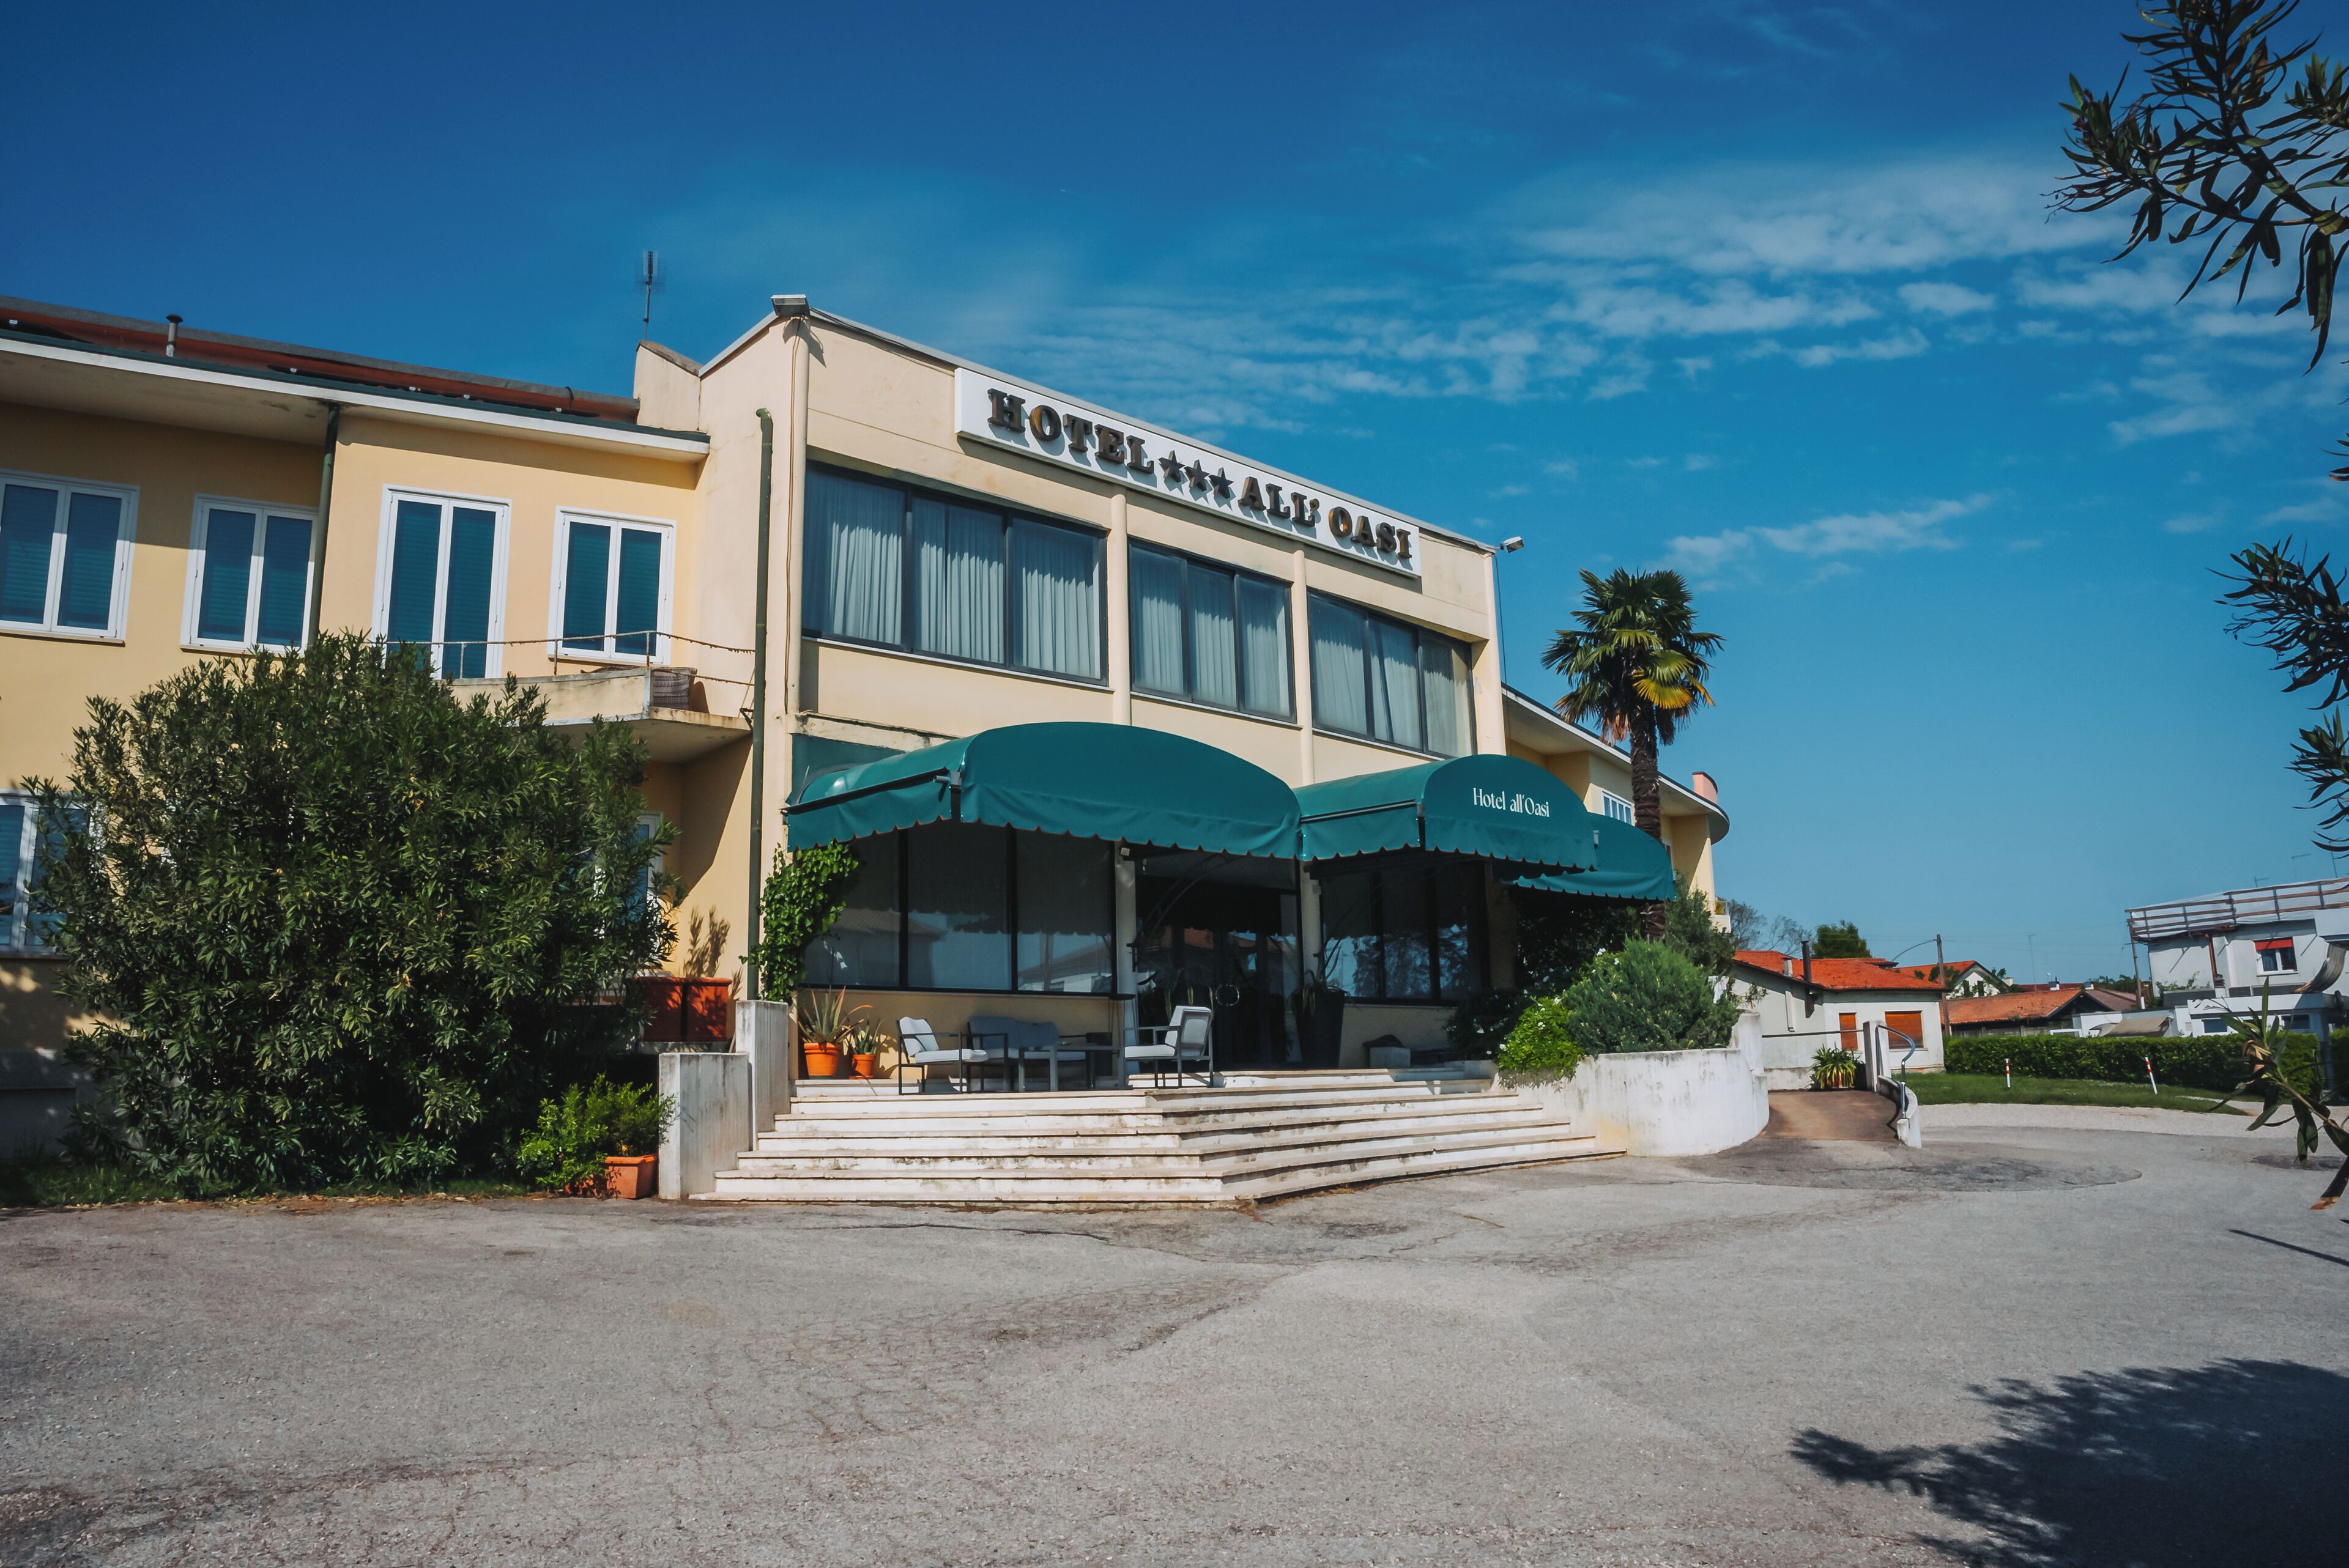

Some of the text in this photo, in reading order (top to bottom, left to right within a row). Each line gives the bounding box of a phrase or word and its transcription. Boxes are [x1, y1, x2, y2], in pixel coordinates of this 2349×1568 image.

[987, 388, 1154, 474] HOTEL
[1473, 787, 1549, 817] Hotel all'Oasi
